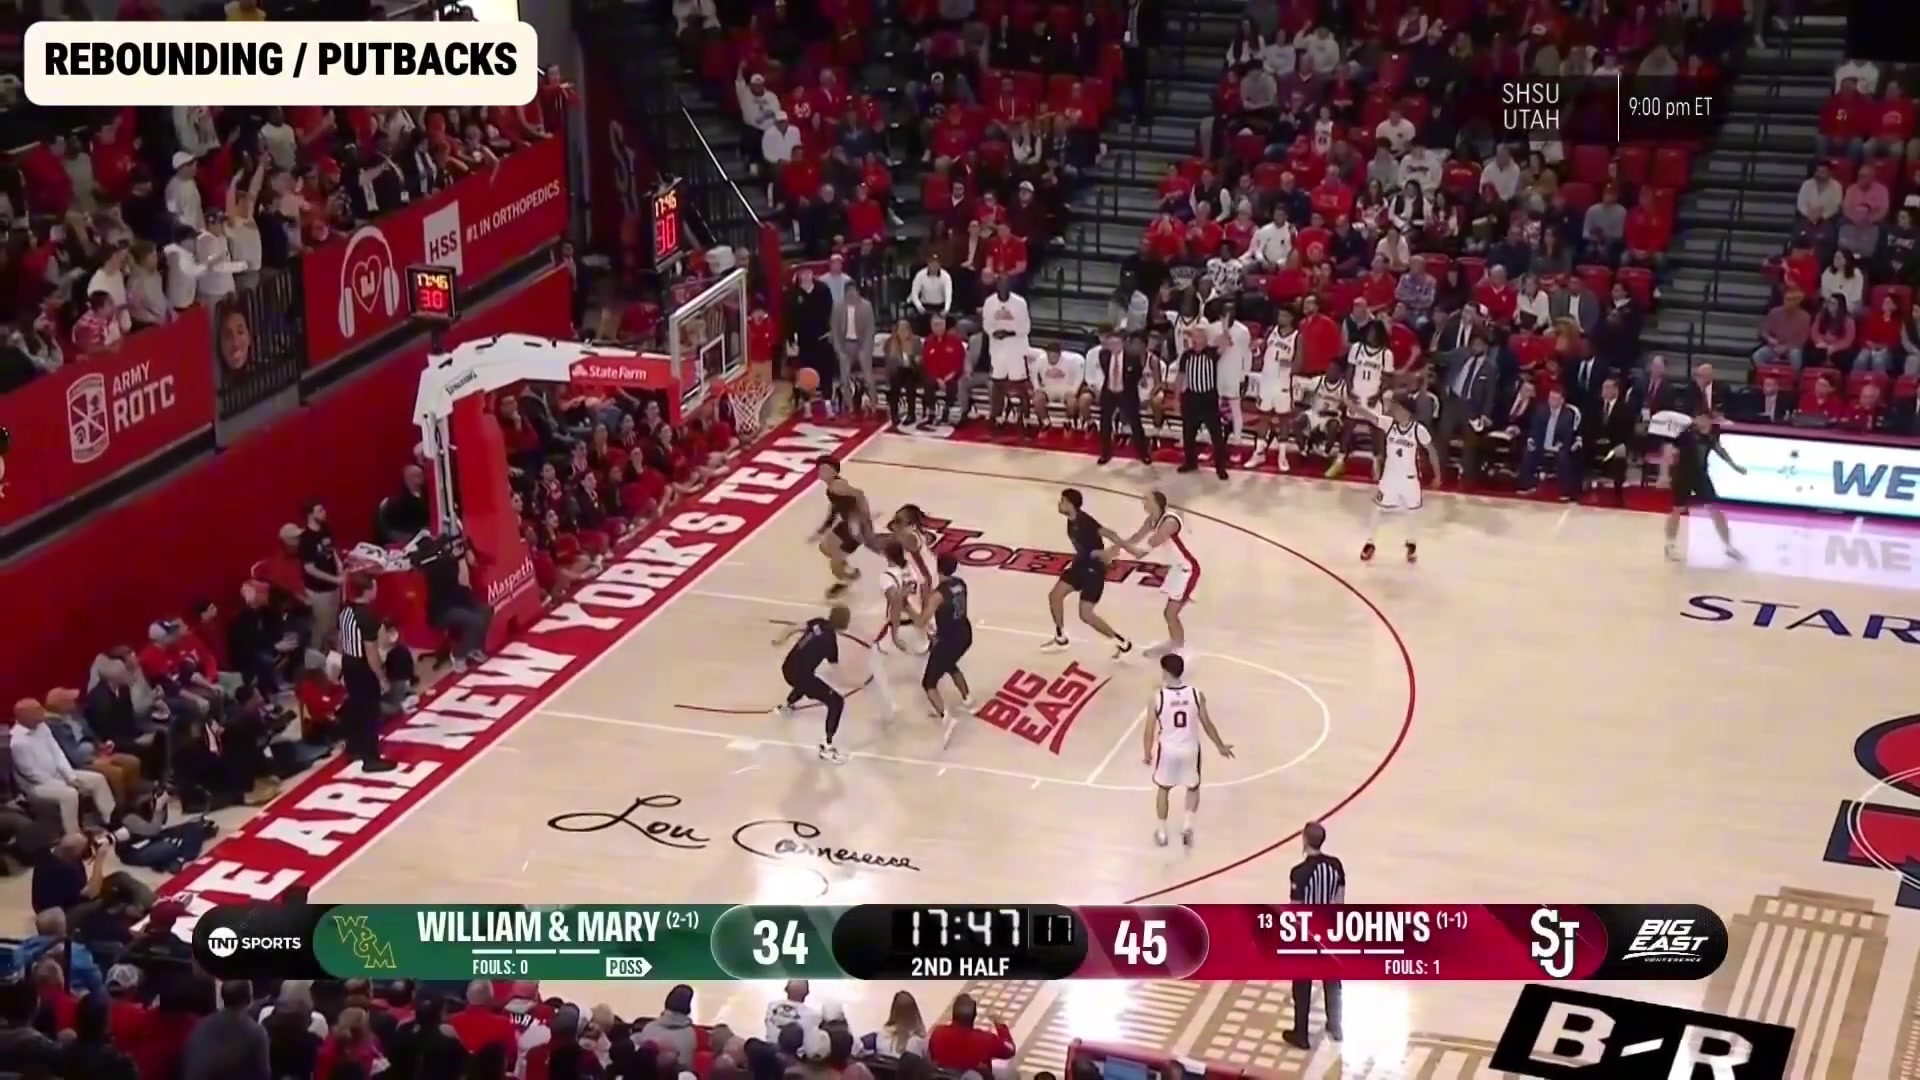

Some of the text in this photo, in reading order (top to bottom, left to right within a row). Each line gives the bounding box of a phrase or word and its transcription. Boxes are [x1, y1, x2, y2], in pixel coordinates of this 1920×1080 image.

[480, 215, 491, 236] IN
[492, 180, 560, 228] ORTHOPEDICS
[429, 231, 458, 263] HSS
[421, 289, 443, 310] 30
[113, 360, 150, 396] ARMY
[113, 375, 175, 433] ROTC
[1396, 448, 1404, 458] 4
[1833, 460, 1920, 501] WE
[255, 760, 443, 857] ARE
[380, 641, 577, 750] NEW
[528, 511, 746, 634] YORK'S
[699, 423, 861, 505] TEAM
[974, 669, 1047, 730] BIG
[1011, 661, 1097, 745] EAST
[1174, 710, 1187, 728] 0
[547, 794, 710, 848] Lou
